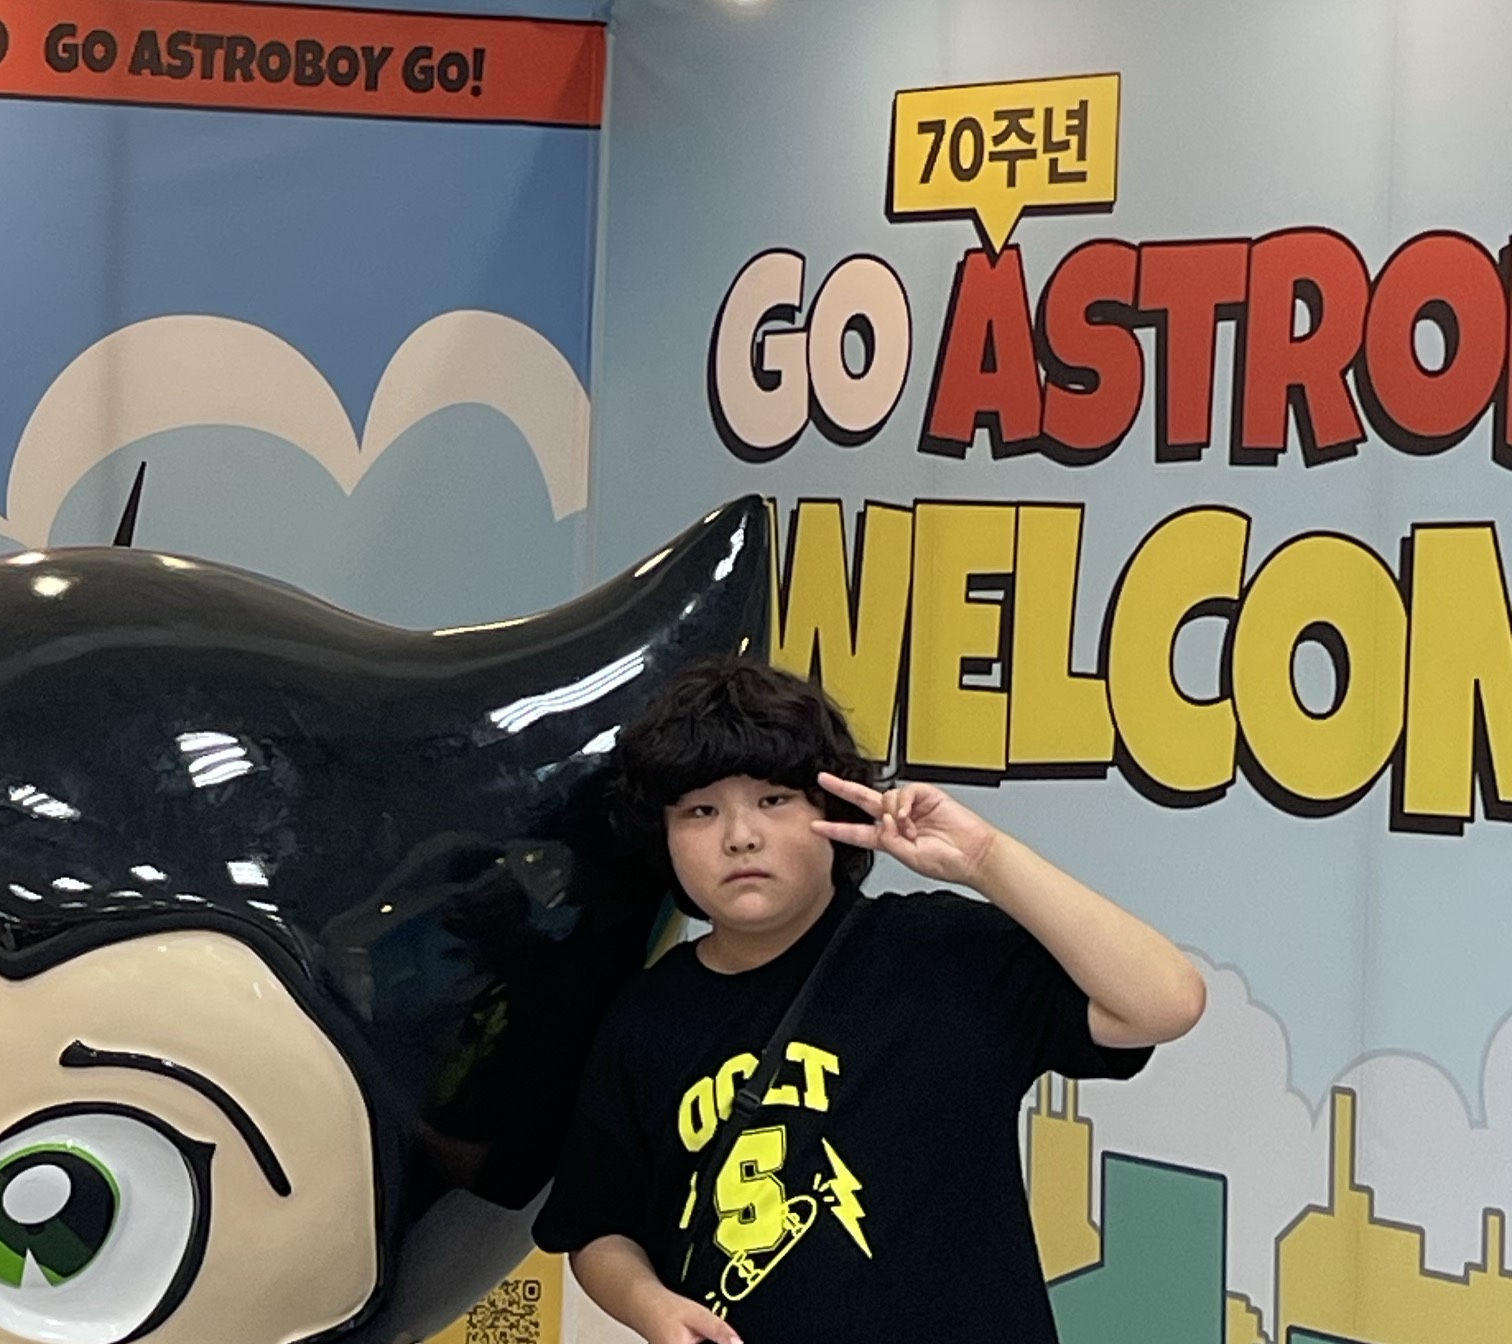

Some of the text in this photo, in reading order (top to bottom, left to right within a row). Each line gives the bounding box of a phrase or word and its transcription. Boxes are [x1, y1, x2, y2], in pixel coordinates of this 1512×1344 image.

[44, 23, 117, 74] GO
[128, 29, 394, 92] ASTROBOY
[402, 45, 486, 98] GO!
[916, 98, 1090, 189] 70주년
[707, 226, 1512, 471] GO ASTRO
